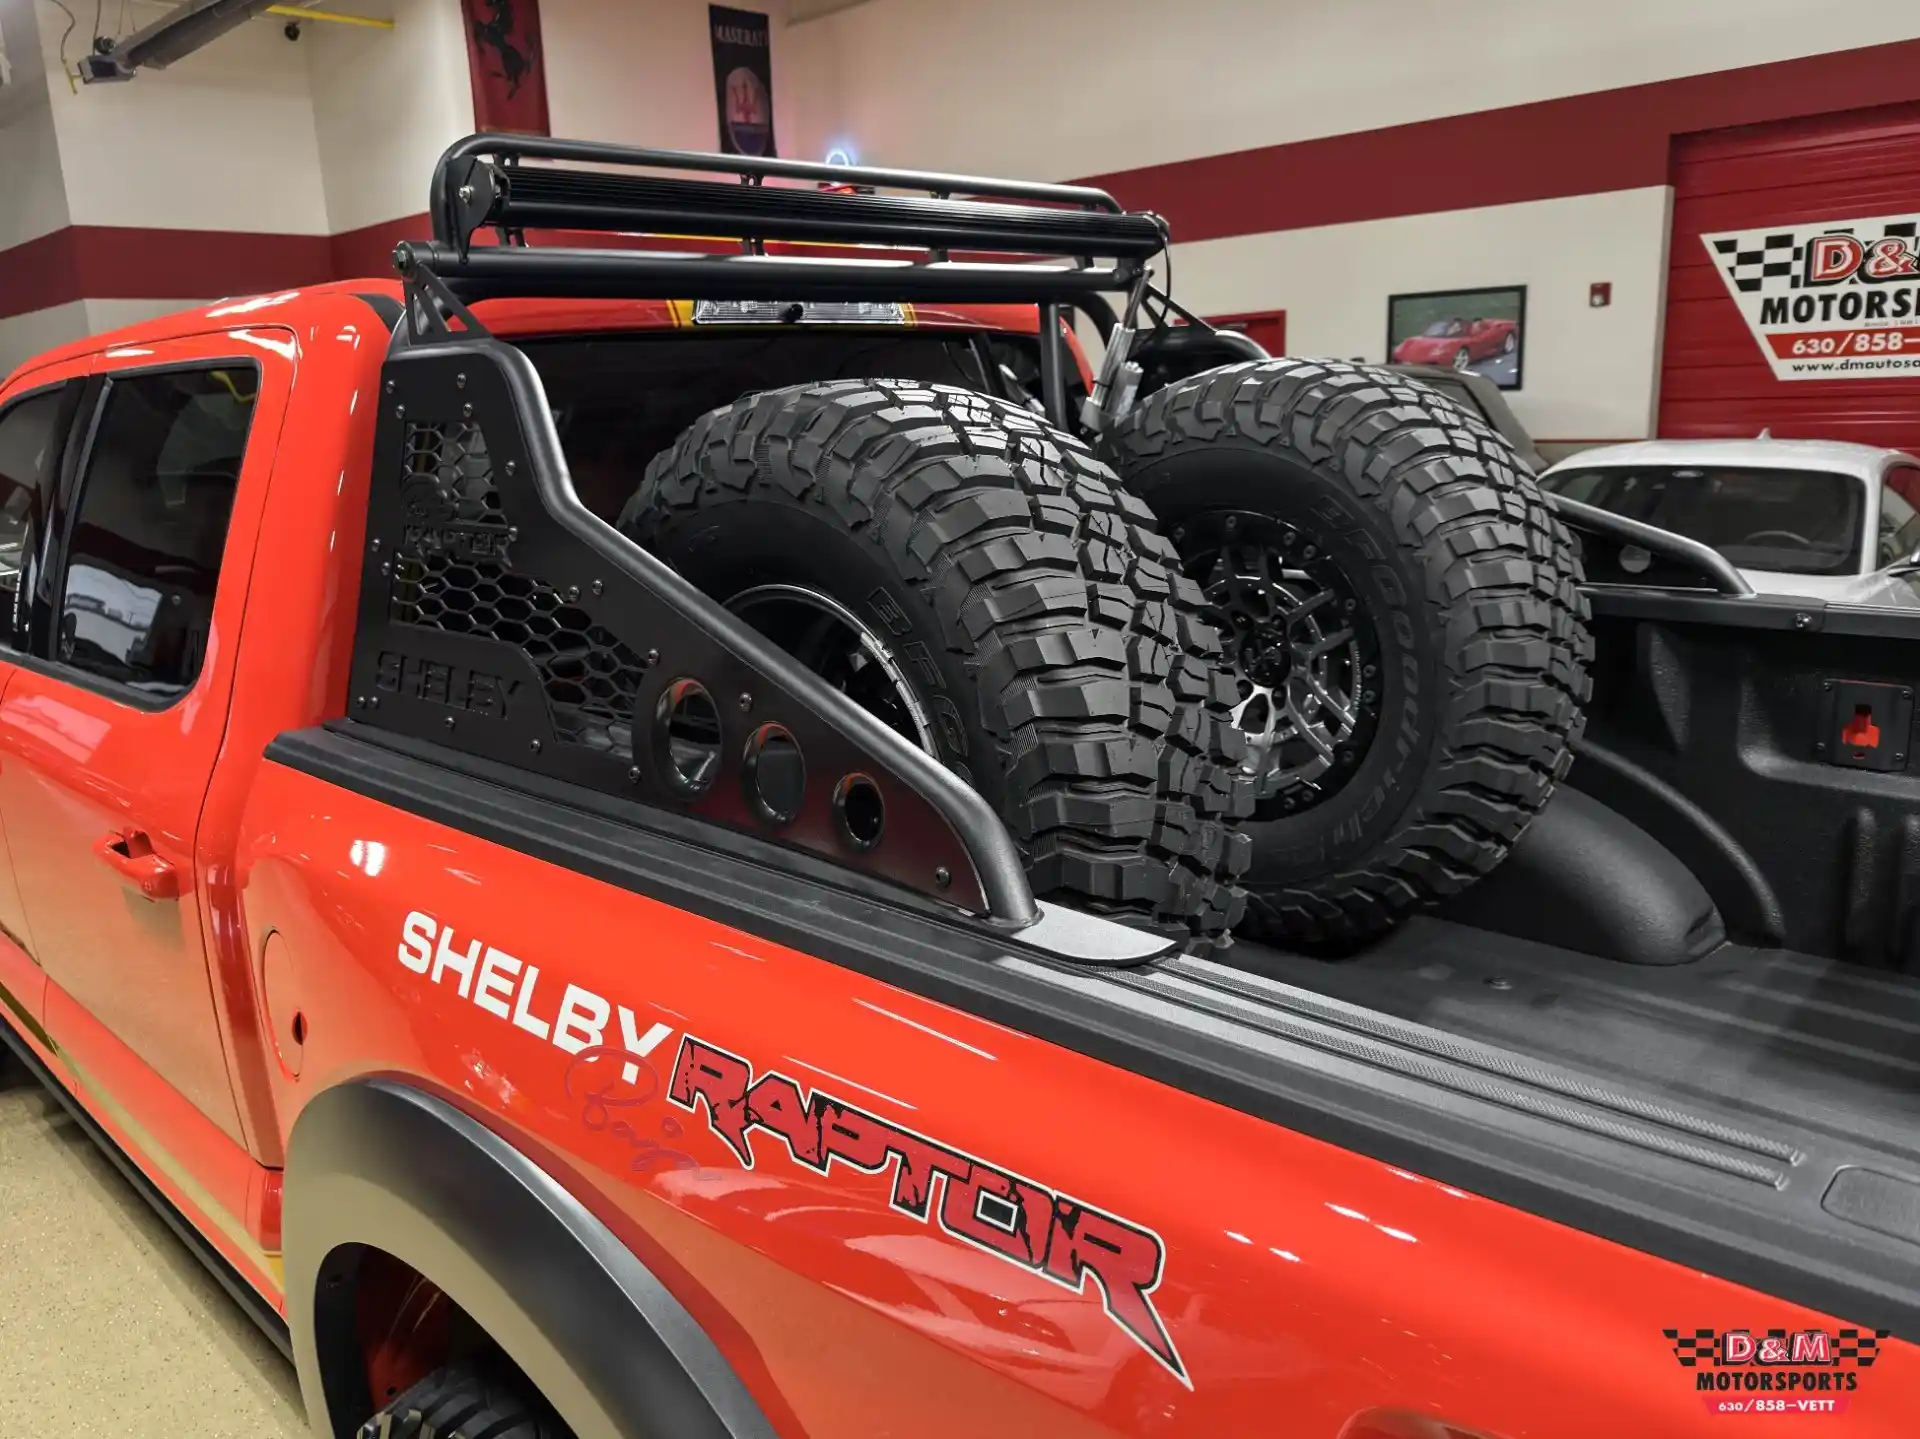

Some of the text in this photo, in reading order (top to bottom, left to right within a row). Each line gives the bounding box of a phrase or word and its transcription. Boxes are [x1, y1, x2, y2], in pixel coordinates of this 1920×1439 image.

[1760, 288, 1920, 325] MOTORS
[376, 650, 524, 720] SHELBY
[398, 911, 674, 1085] SHELBY
[668, 1033, 1194, 1391] RAPTOR
